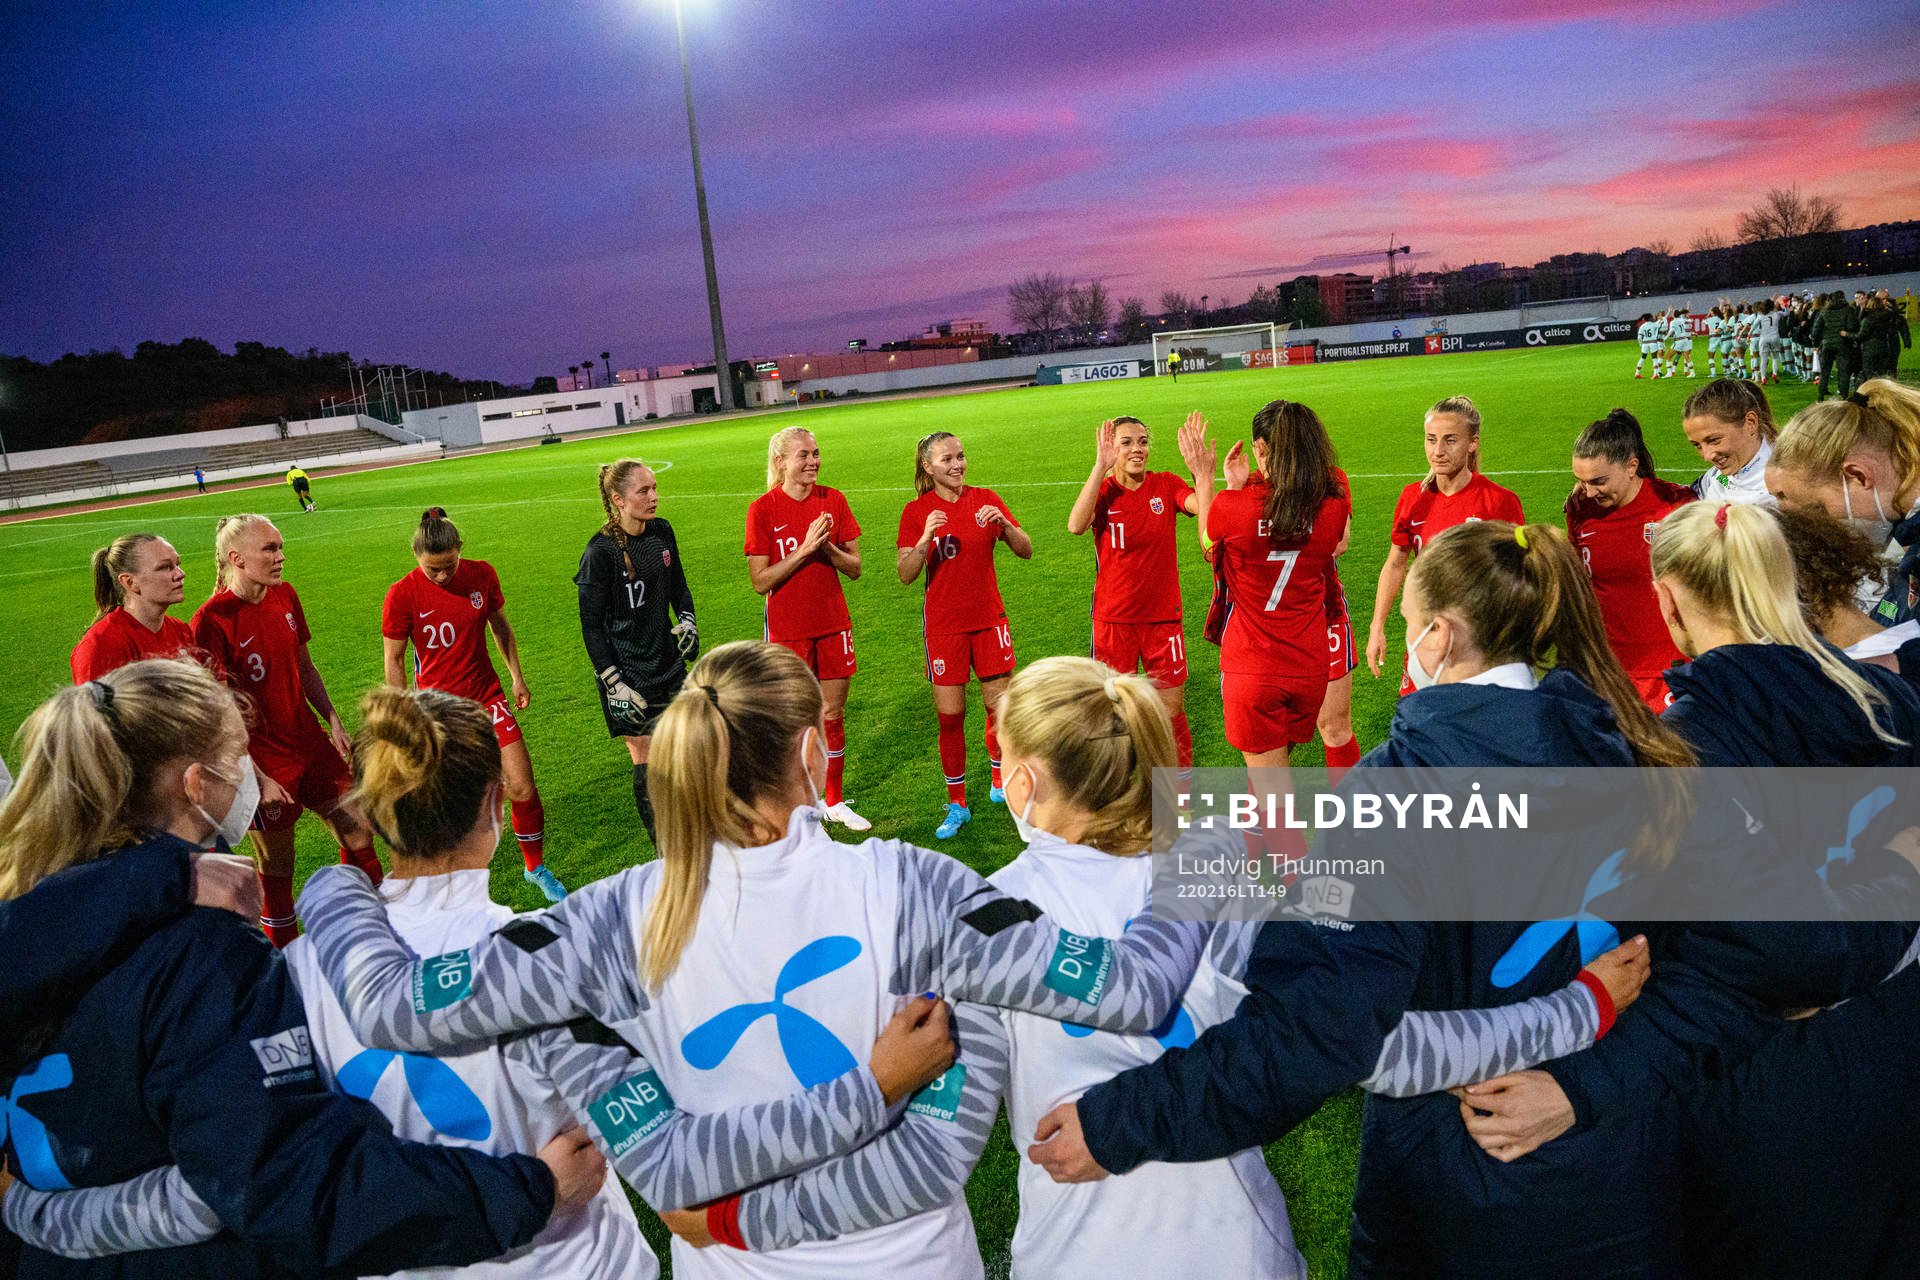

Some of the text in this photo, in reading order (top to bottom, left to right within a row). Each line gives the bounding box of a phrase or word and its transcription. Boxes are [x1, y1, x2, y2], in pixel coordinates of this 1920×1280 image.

[1544, 328, 1572, 337] altice
[1603, 323, 1632, 333] altice
[1324, 342, 1410, 357] PORTUGALSTORE.FPF.PT
[1441, 336, 1463, 350] BPI
[1254, 350, 1289, 365] SAGES
[1084, 364, 1128, 380] LAGOS
[932, 534, 957, 561] 16
[1108, 522, 1125, 550] 11
[625, 580, 646, 609] 12
[1264, 550, 1301, 612] 7
[422, 622, 456, 649] 20
[994, 625, 1011, 649] 16
[1168, 634, 1184, 663] 11
[247, 653, 266, 682] 3
[1058, 935, 1093, 980] DNB
[262, 1029, 309, 1068] DNB
[605, 1081, 659, 1126] DNB
